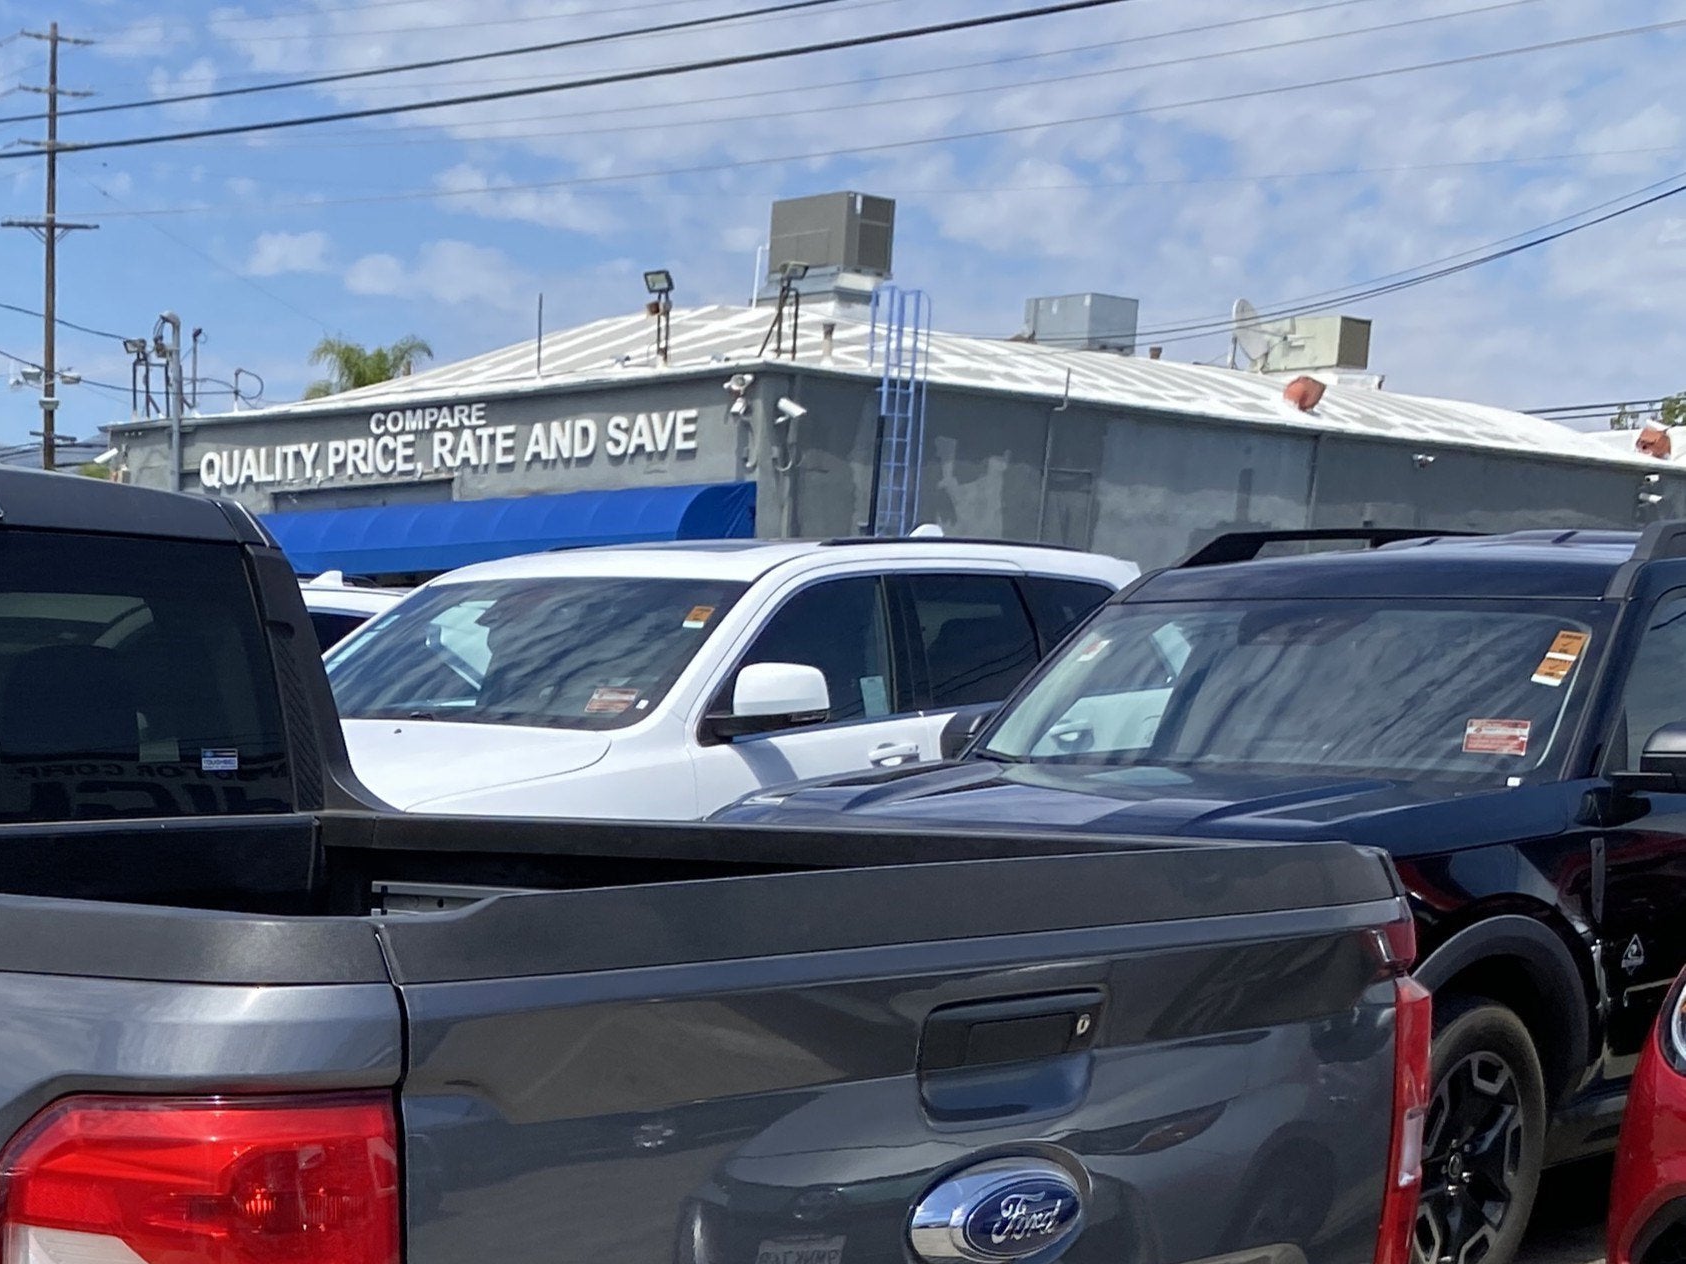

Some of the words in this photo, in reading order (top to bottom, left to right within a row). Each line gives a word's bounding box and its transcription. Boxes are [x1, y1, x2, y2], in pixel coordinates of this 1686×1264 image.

[370, 403, 487, 435] COMPARE
[200, 442, 324, 489] QUALITY,
[328, 434, 423, 479] PRICE,
[433, 425, 516, 468] RATE
[524, 418, 598, 462] AND
[605, 409, 698, 456] SAVE
[991, 1190, 1062, 1244] Ford
